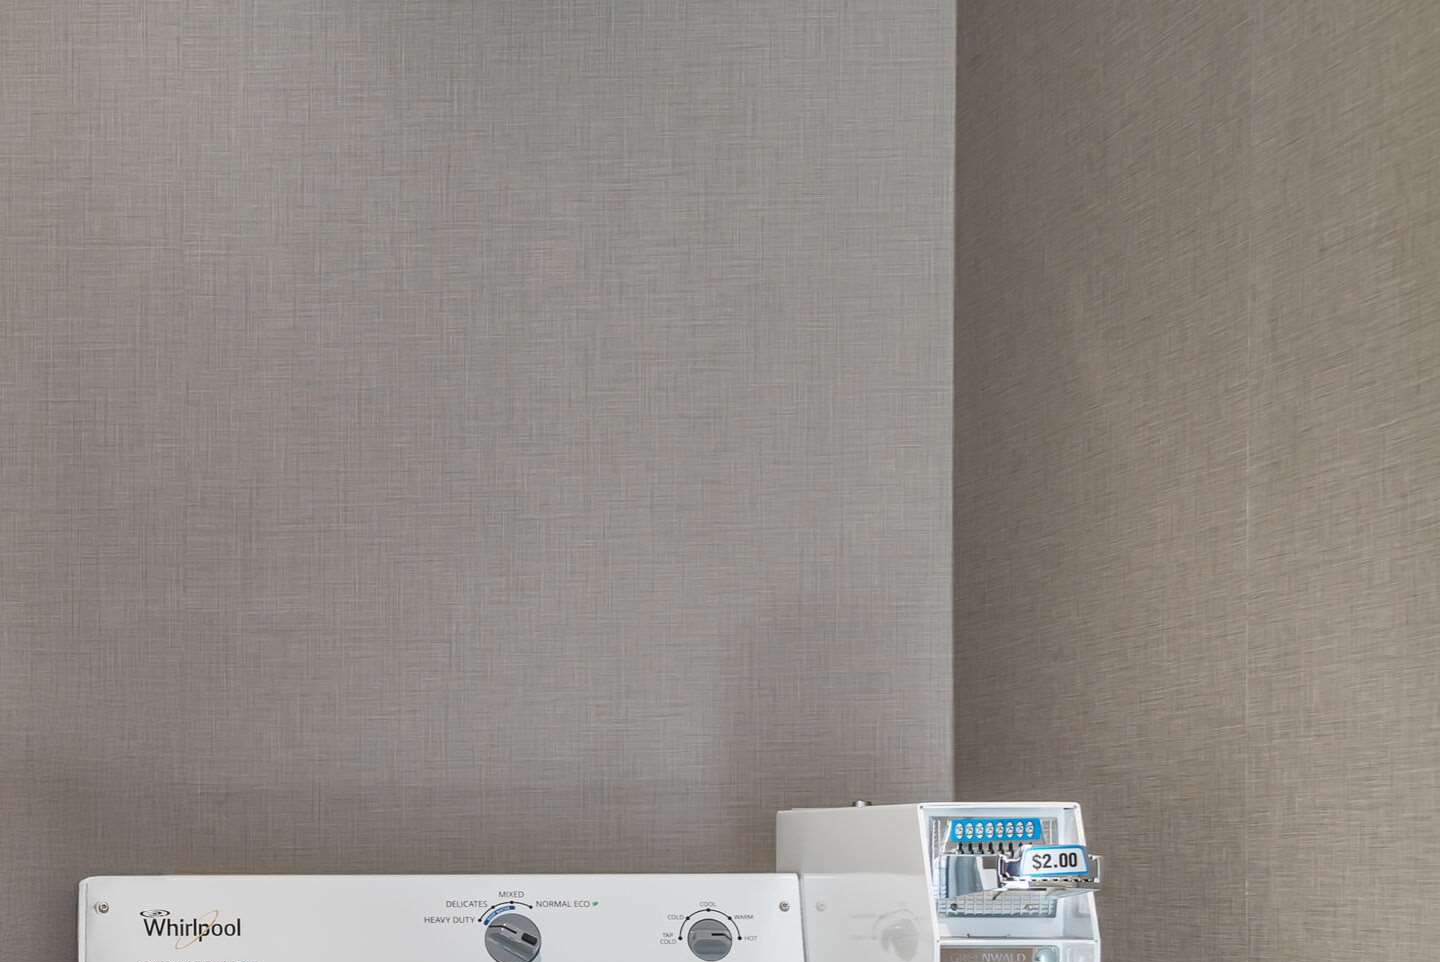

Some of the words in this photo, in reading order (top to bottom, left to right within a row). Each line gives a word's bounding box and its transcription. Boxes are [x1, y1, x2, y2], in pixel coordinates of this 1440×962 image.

[1032, 852, 1078, 870] $2.00
[498, 891, 525, 899] MIXED
[445, 900, 488, 908] DELICATES
[535, 900, 572, 908] NORMAL
[574, 900, 591, 908] ECO
[424, 917, 451, 925] HEAVY
[453, 917, 476, 925] DUTY
[143, 917, 241, 942] Whirlpool
